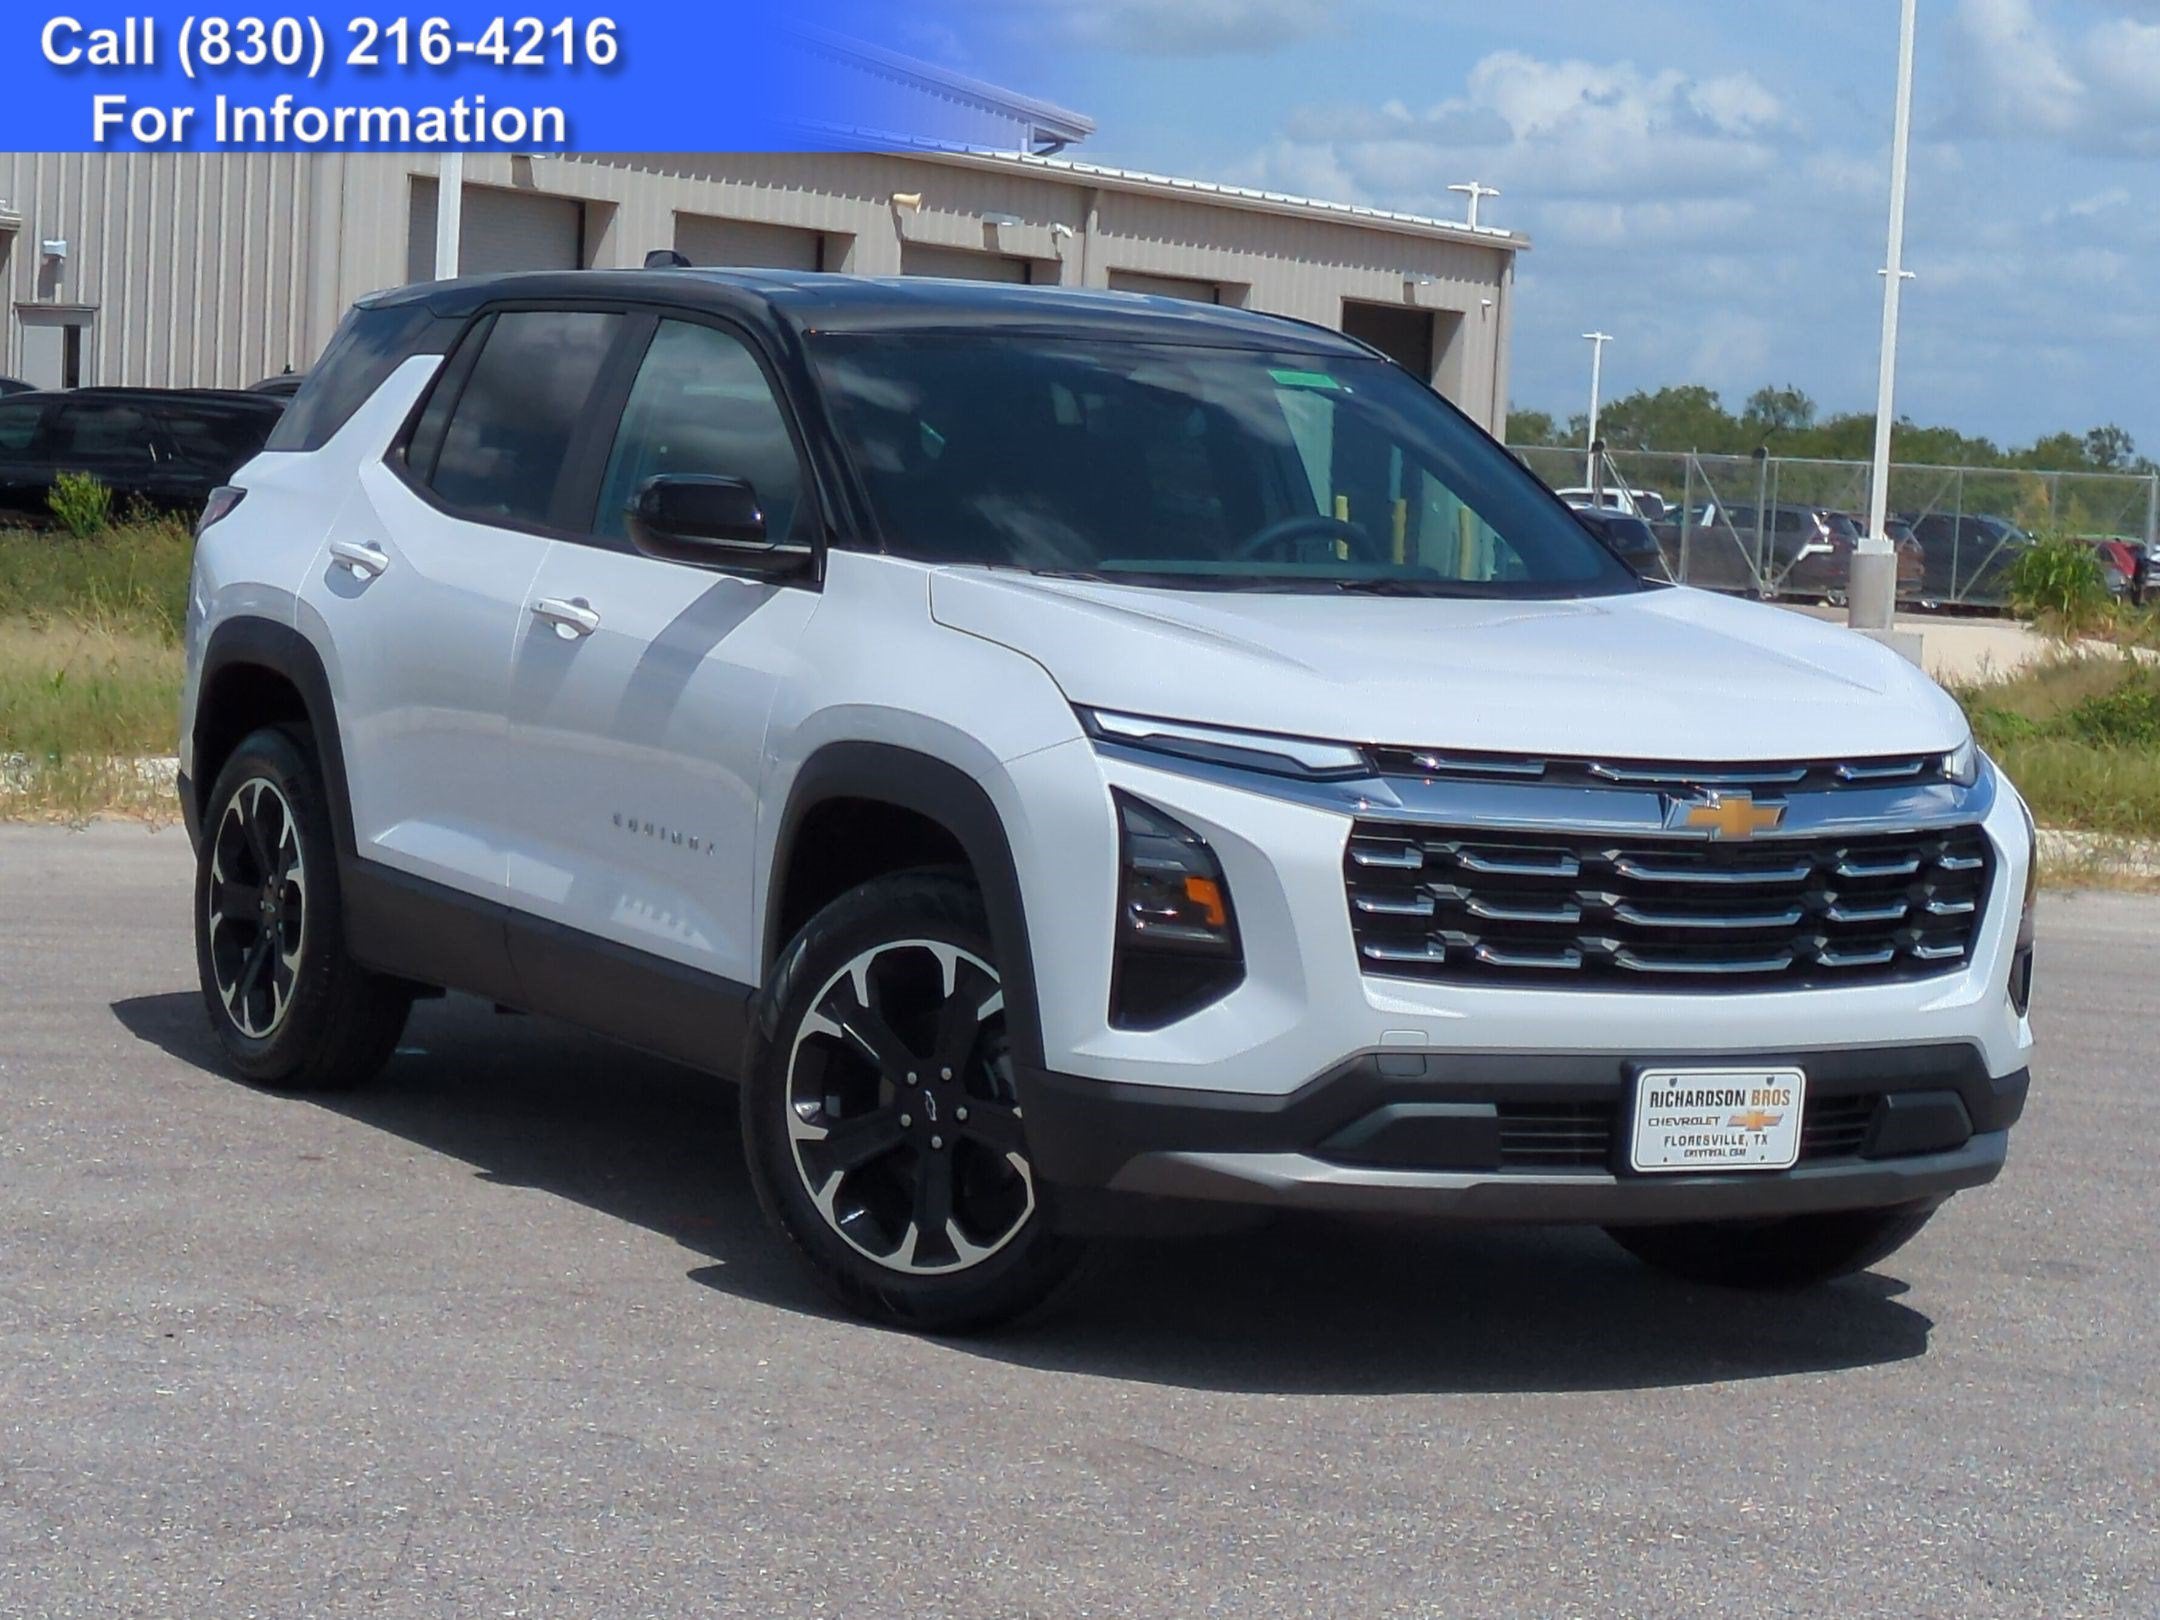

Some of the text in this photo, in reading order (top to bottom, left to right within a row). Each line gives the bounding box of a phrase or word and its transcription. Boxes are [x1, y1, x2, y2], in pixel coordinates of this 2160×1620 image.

[1649, 1088, 1791, 1108] RICHARDSON BROS
[1648, 1115, 1721, 1127] CHEVROLET
[1754, 1133, 1769, 1146] TX
